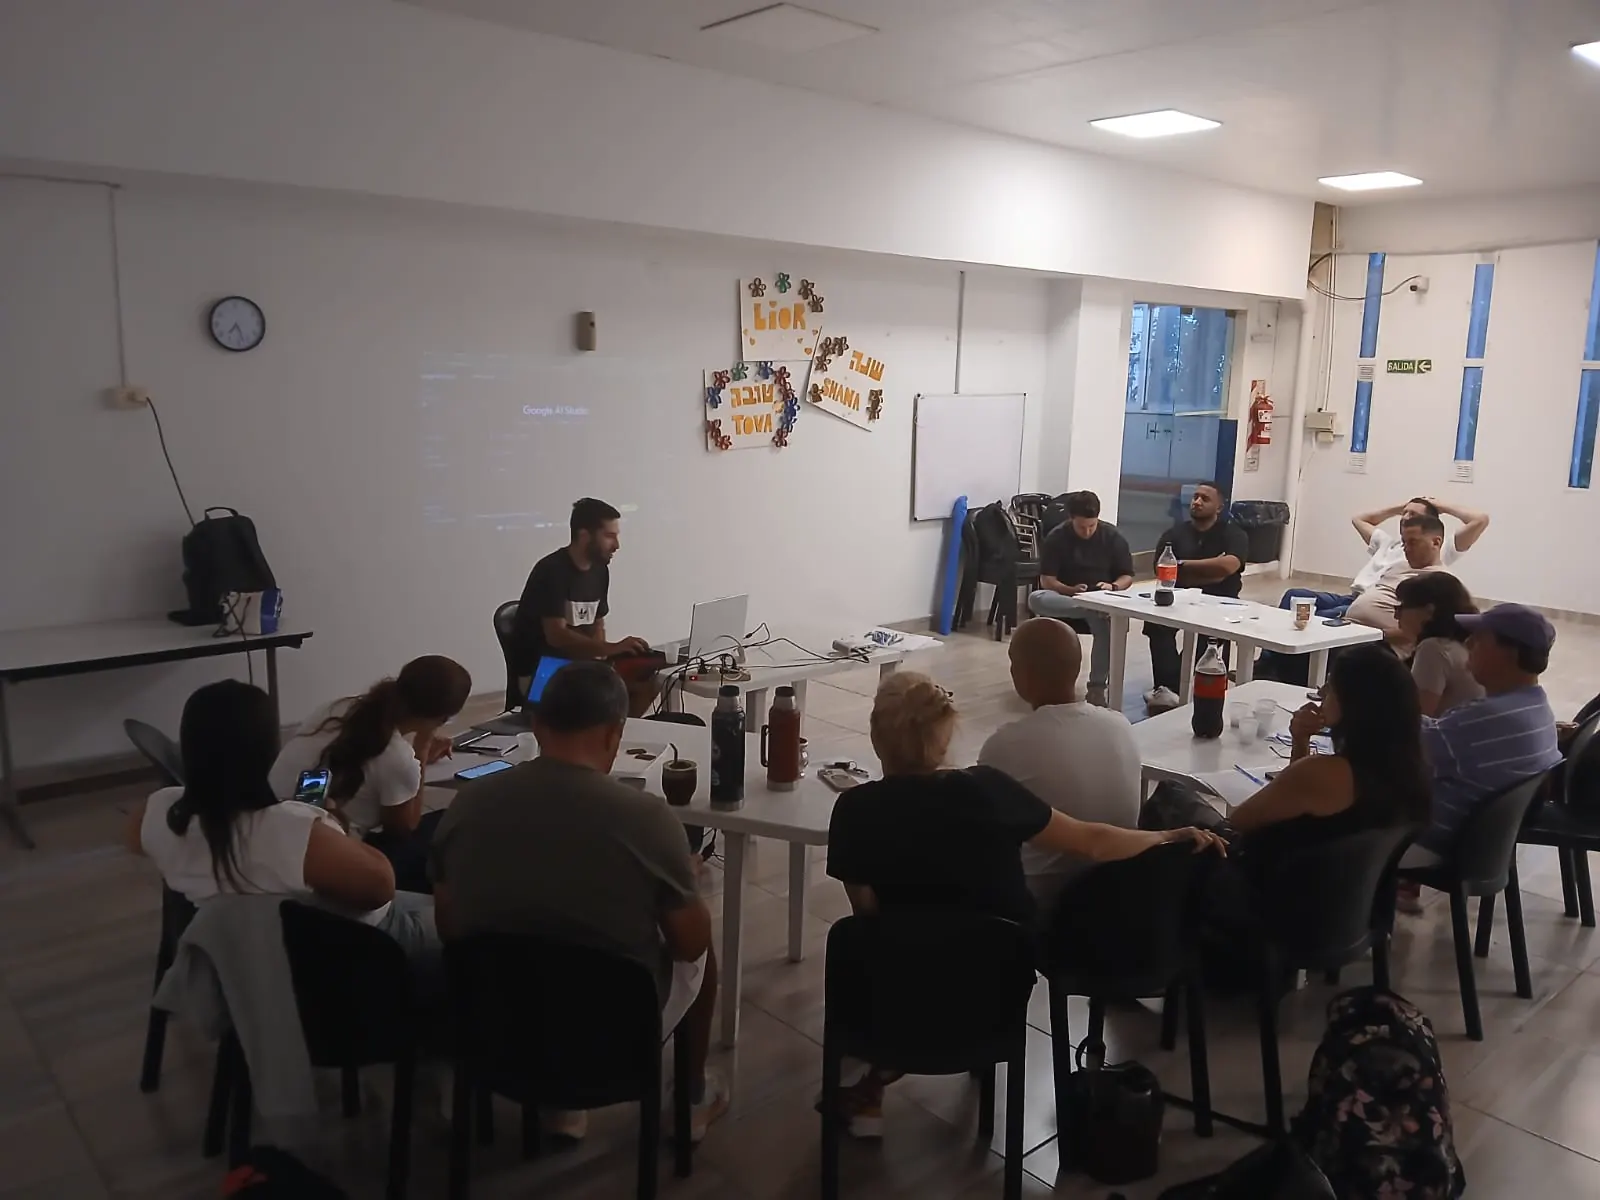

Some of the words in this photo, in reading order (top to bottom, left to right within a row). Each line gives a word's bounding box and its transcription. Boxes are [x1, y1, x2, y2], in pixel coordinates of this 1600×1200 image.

[849, 350, 885, 382] שנה
[1387, 362, 1414, 371] SALIDA
[730, 383, 774, 408] טובה
[822, 378, 860, 412] SHANA
[522, 404, 553, 417] Google
[731, 413, 773, 435] TOVA
